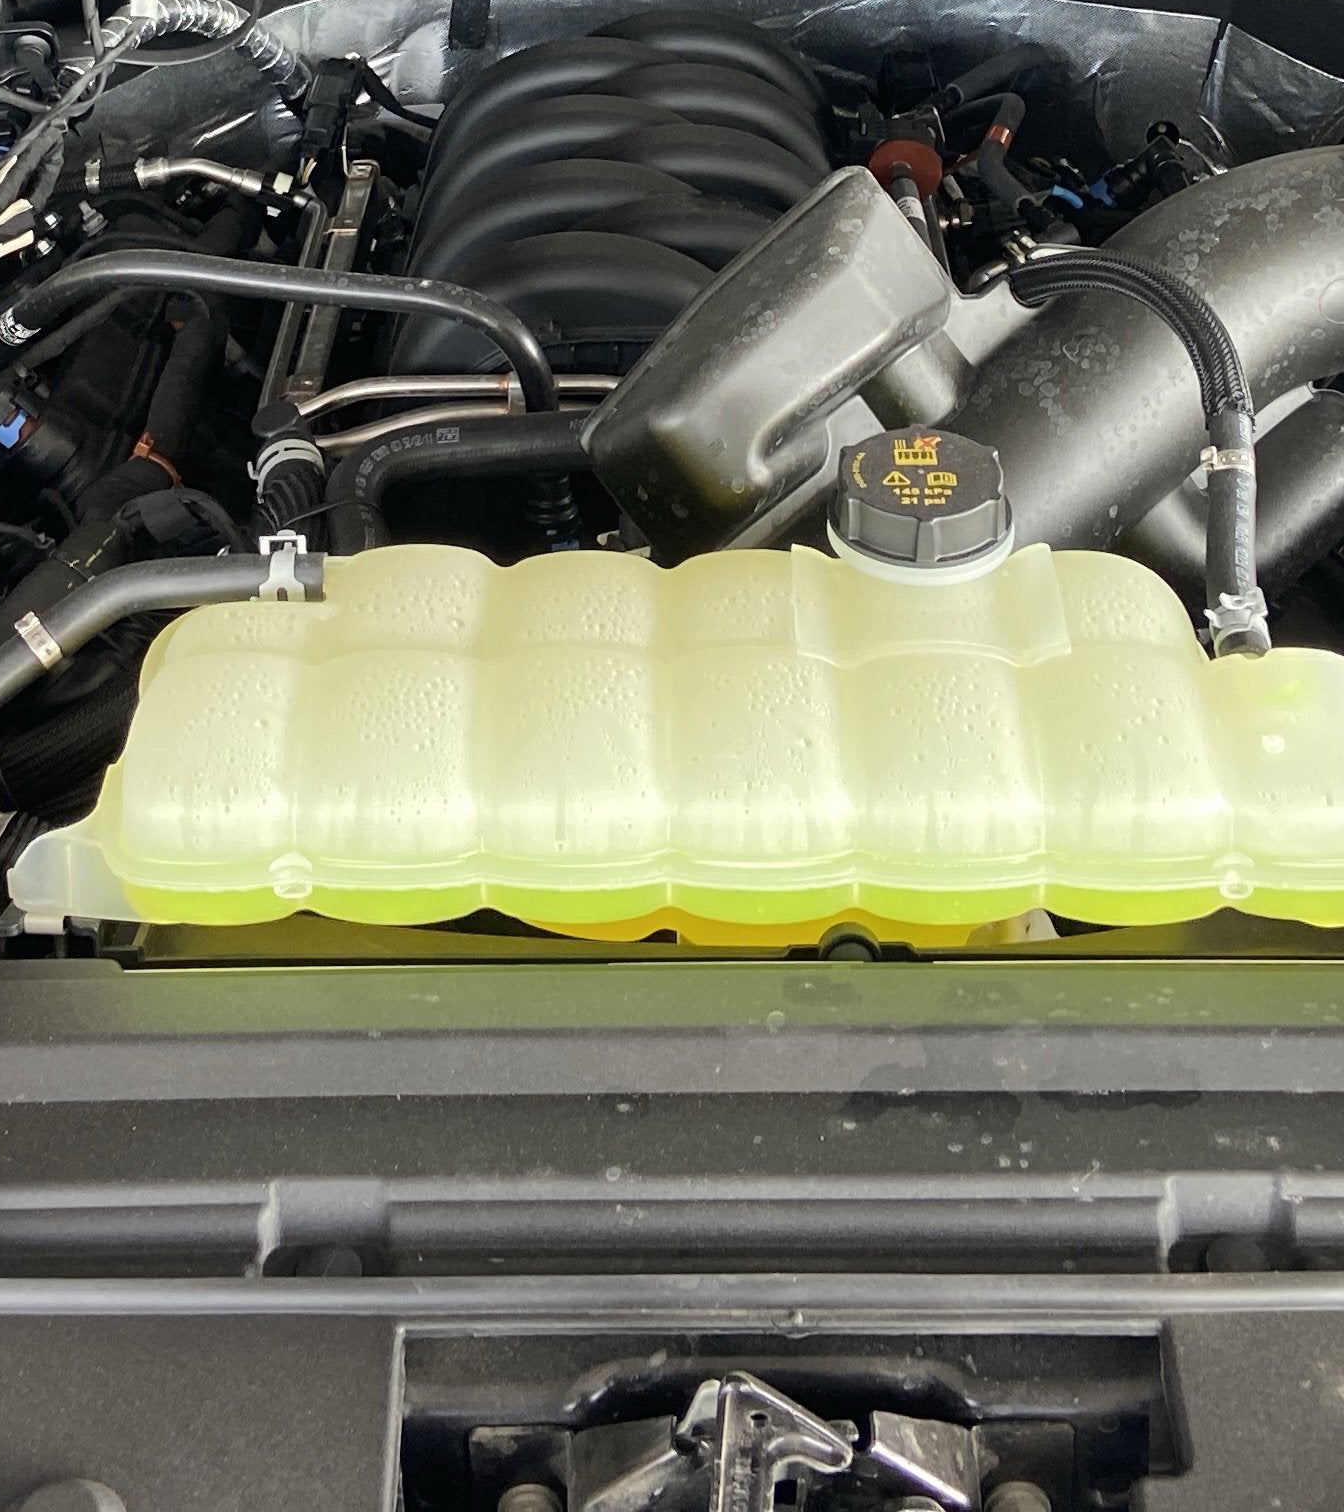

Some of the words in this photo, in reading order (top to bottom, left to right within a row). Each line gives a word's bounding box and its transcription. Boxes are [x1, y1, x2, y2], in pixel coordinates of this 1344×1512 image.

[924, 488, 952, 496] kPa
[901, 497, 918, 505] 21
[924, 496, 946, 506] psi
